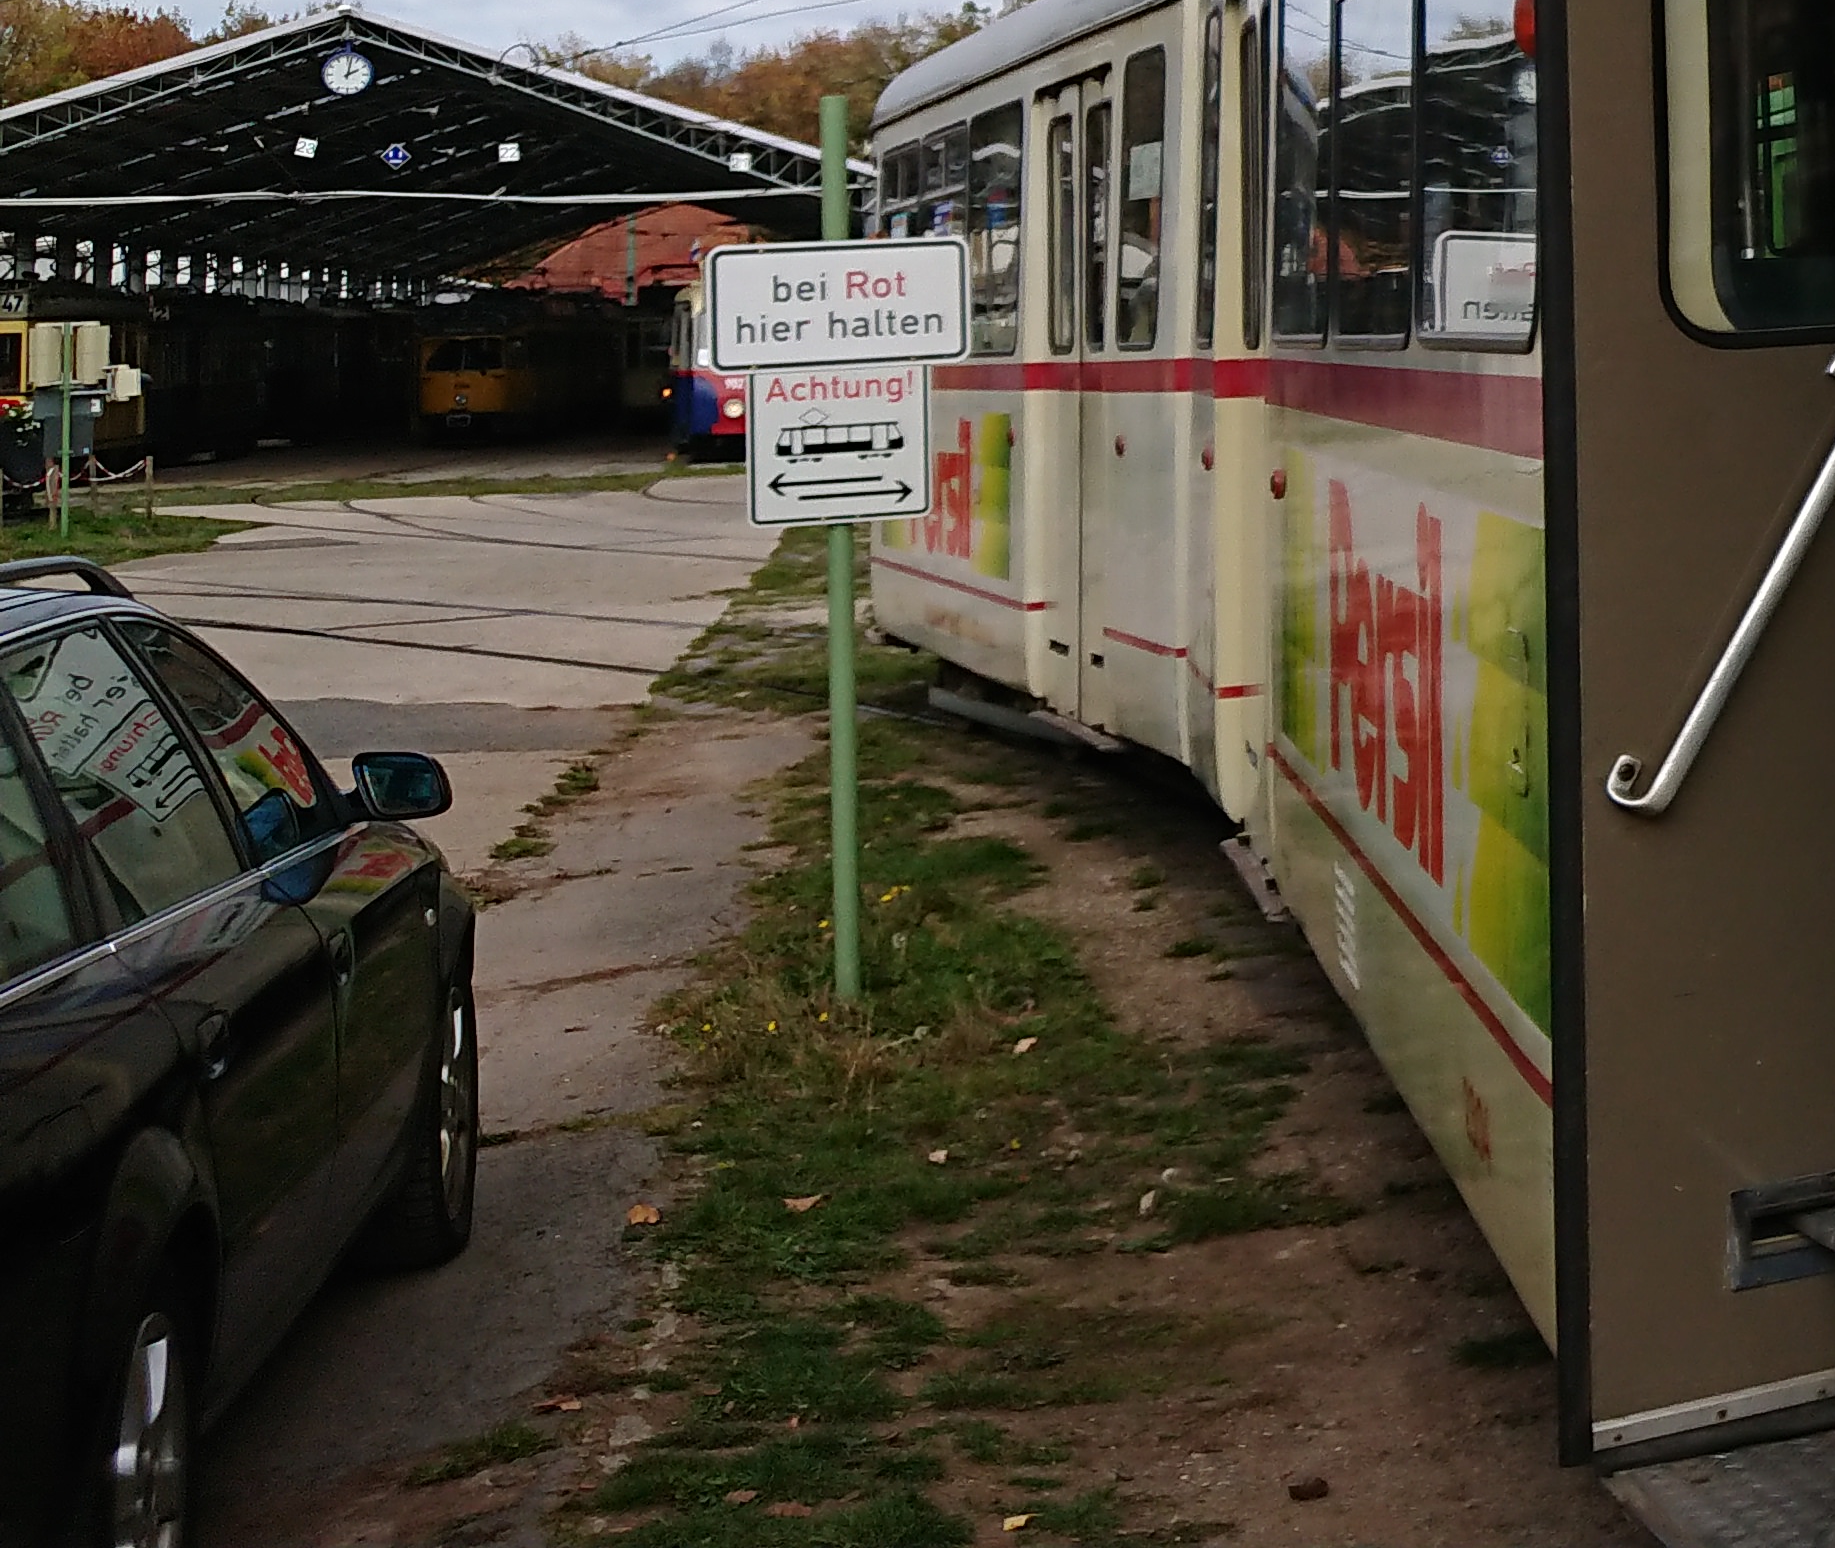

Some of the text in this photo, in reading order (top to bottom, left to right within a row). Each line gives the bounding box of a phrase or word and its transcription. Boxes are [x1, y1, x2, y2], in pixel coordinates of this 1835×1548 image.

[296, 139, 316, 155] 23
[500, 146, 519, 159] 22
[771, 270, 907, 303] bei Rot
[735, 308, 943, 345] hier halten
[764, 369, 914, 403] Achtung!
[1329, 478, 1444, 889] Persil
